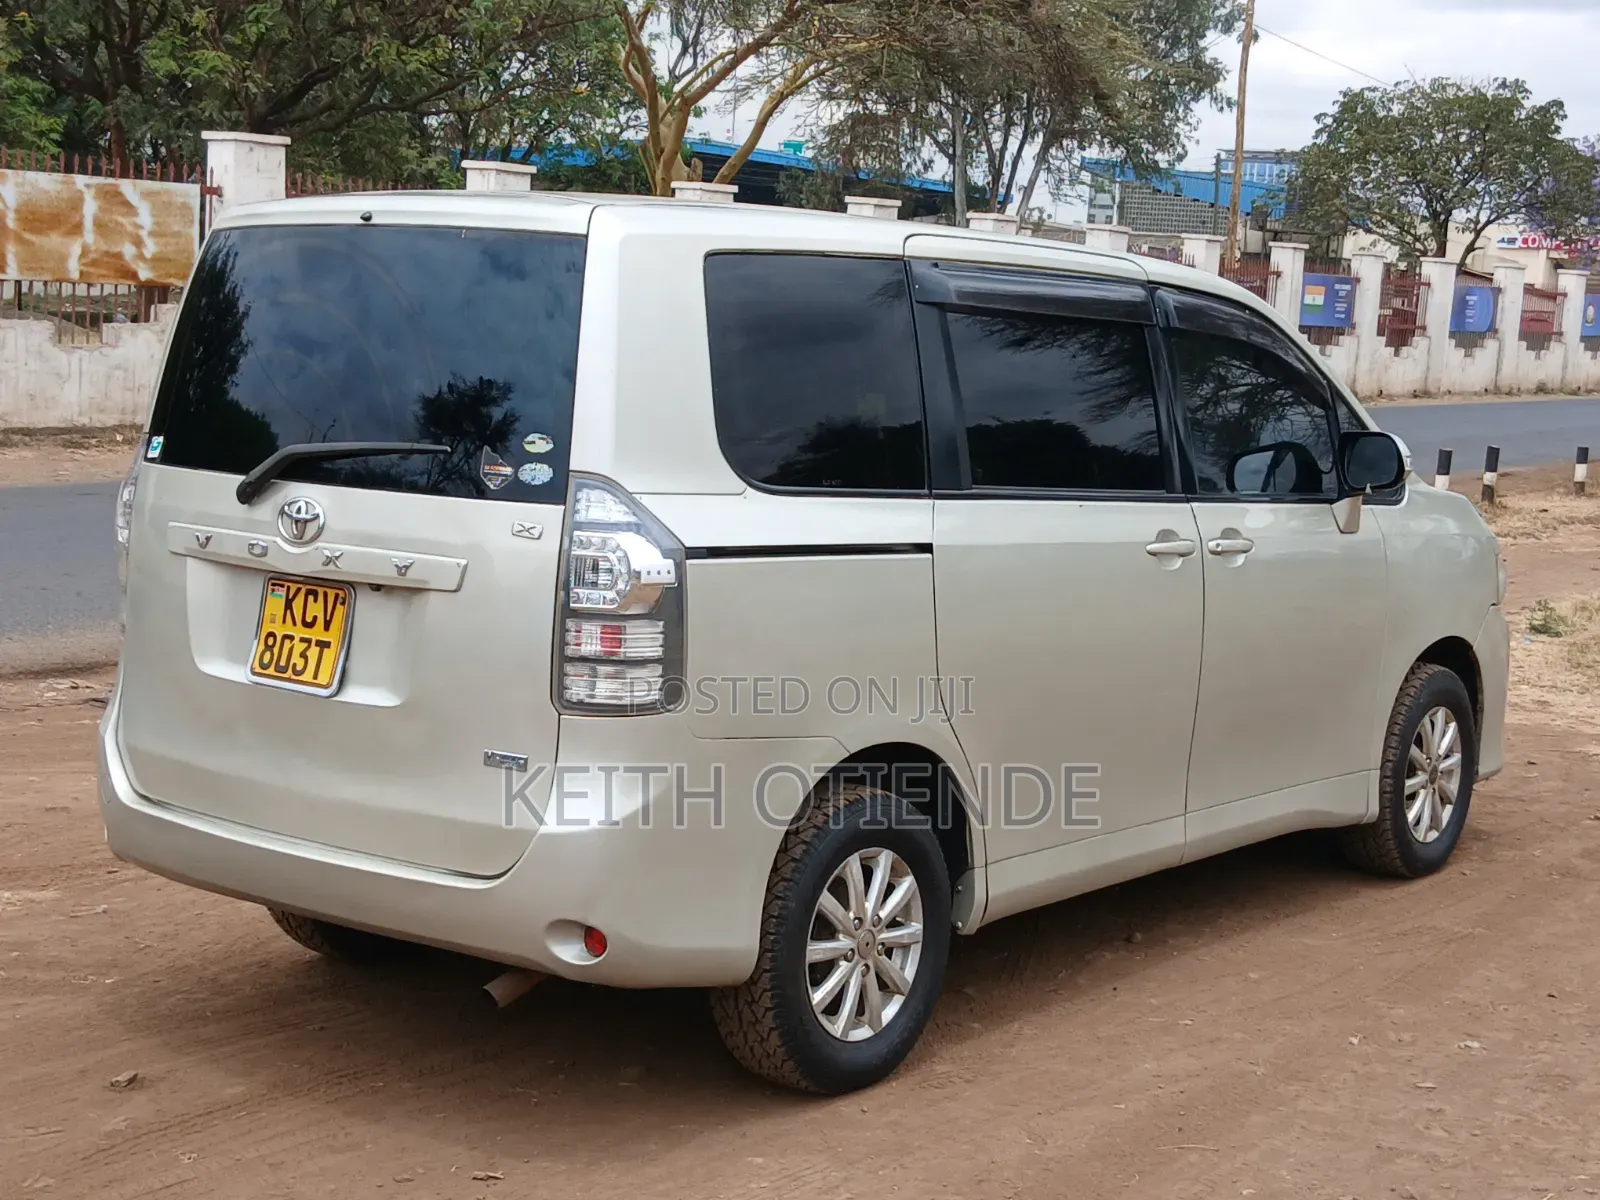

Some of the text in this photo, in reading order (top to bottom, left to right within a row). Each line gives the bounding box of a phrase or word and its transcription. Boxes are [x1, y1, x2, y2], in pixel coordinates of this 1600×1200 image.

[194, 531, 416, 577] VOXY
[282, 584, 340, 632] KCV
[258, 630, 332, 681] 803T
